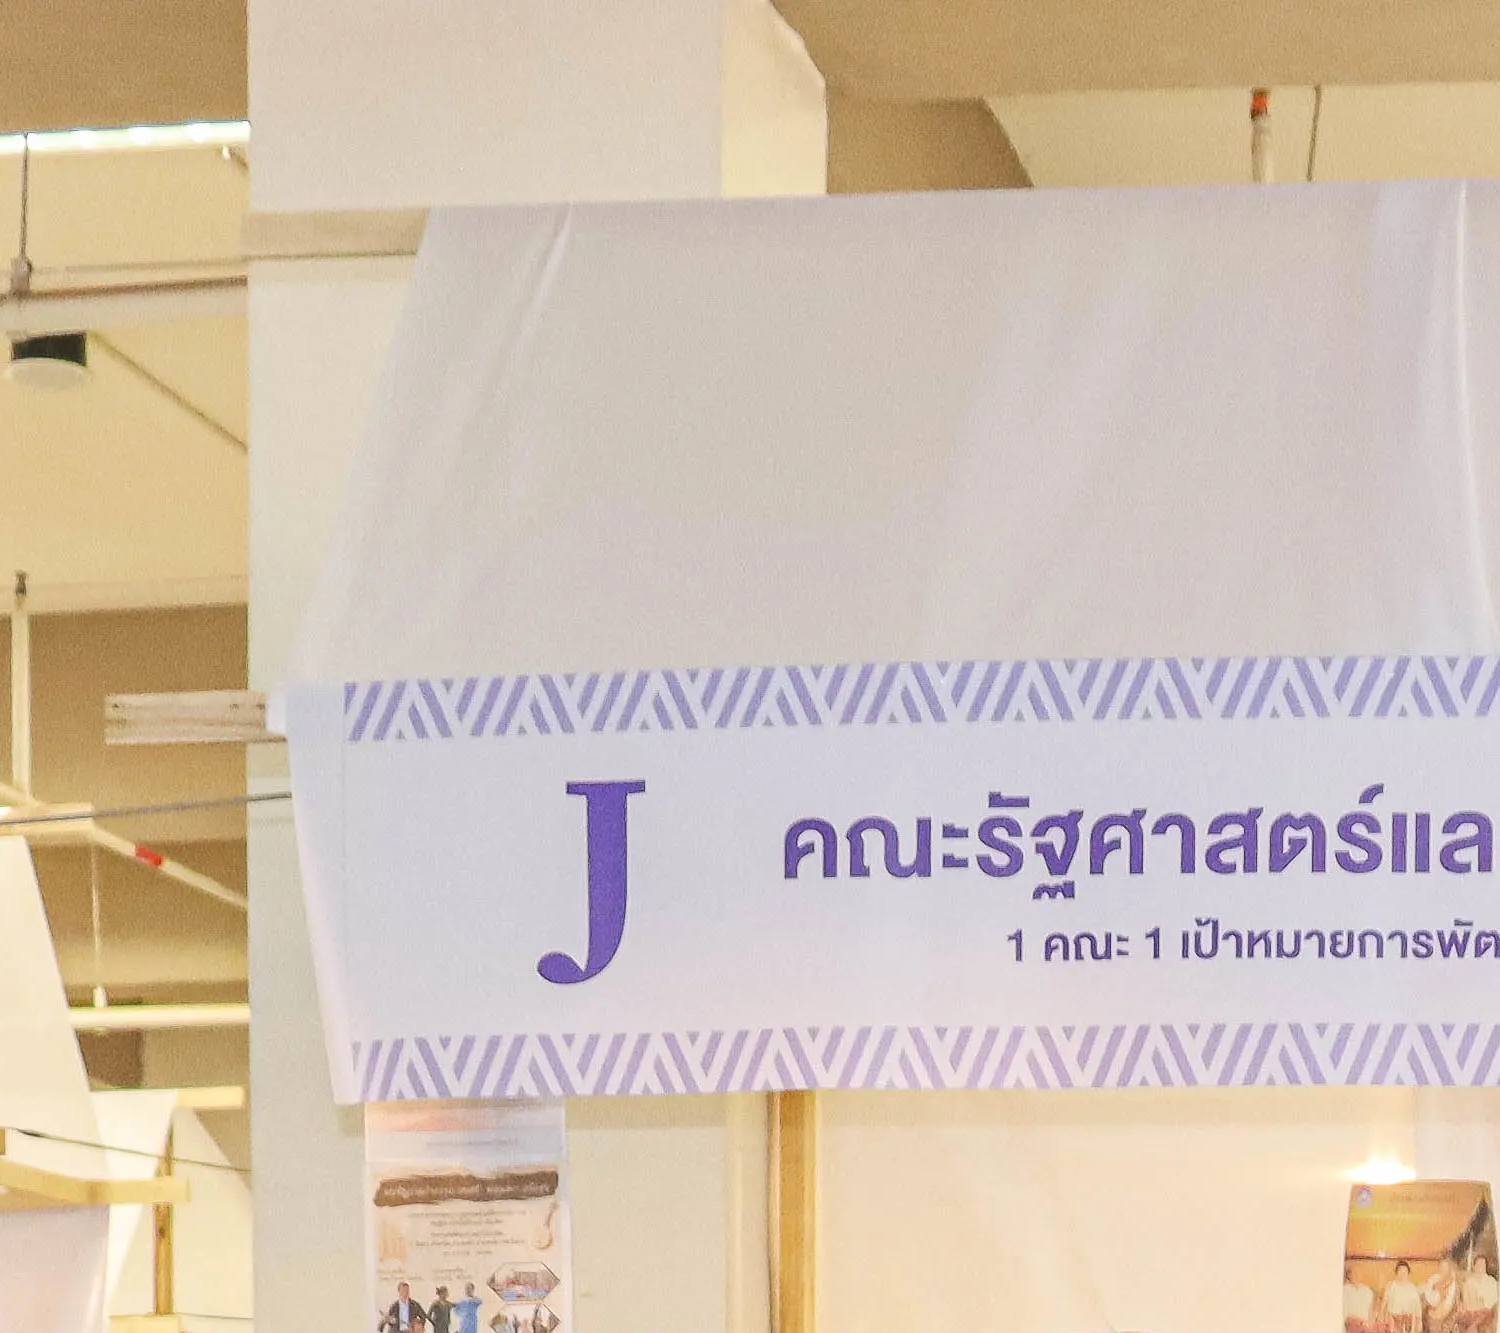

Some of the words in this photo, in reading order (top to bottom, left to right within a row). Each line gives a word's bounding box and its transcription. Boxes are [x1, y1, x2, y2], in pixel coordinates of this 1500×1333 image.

[537, 780, 646, 984] J
[1007, 929, 1024, 962] 1
[1044, 929, 1130, 962] คณะ
[1145, 928, 1162, 959] 1
